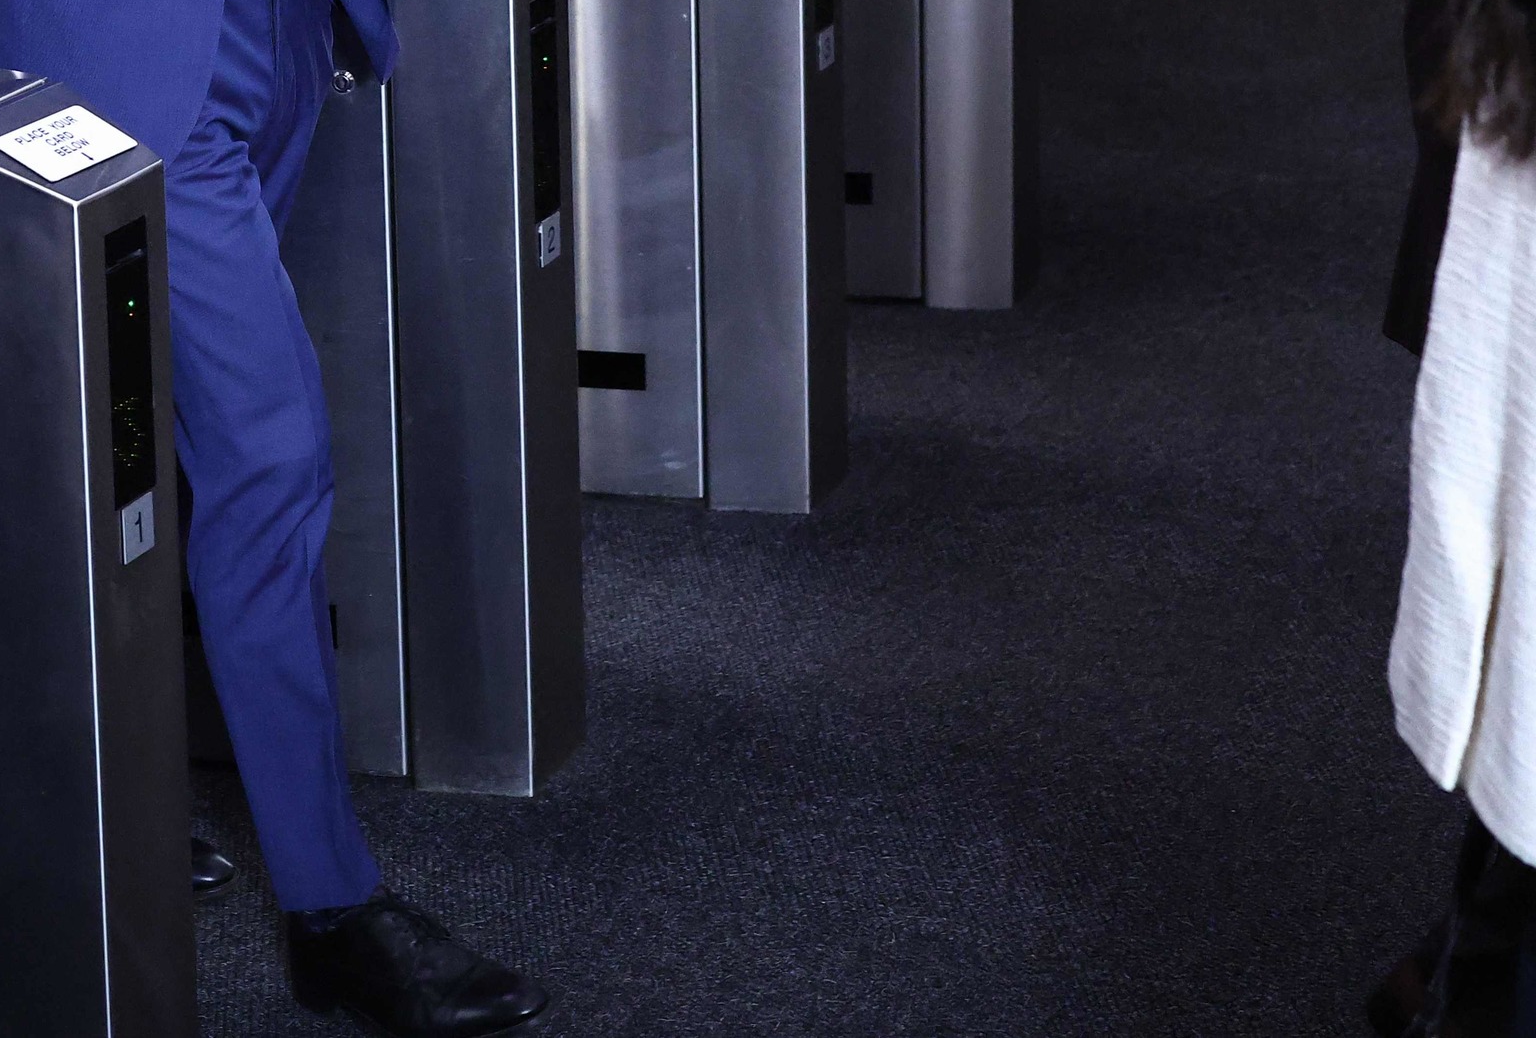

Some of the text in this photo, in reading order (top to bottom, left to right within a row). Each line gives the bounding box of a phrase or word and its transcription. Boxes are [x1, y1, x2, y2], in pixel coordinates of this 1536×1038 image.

[14, 115, 78, 146] PLACE YOUR
[45, 130, 75, 147] CARD
[54, 138, 91, 157] BELOW
[546, 225, 556, 254] 2
[133, 511, 143, 543] 1
